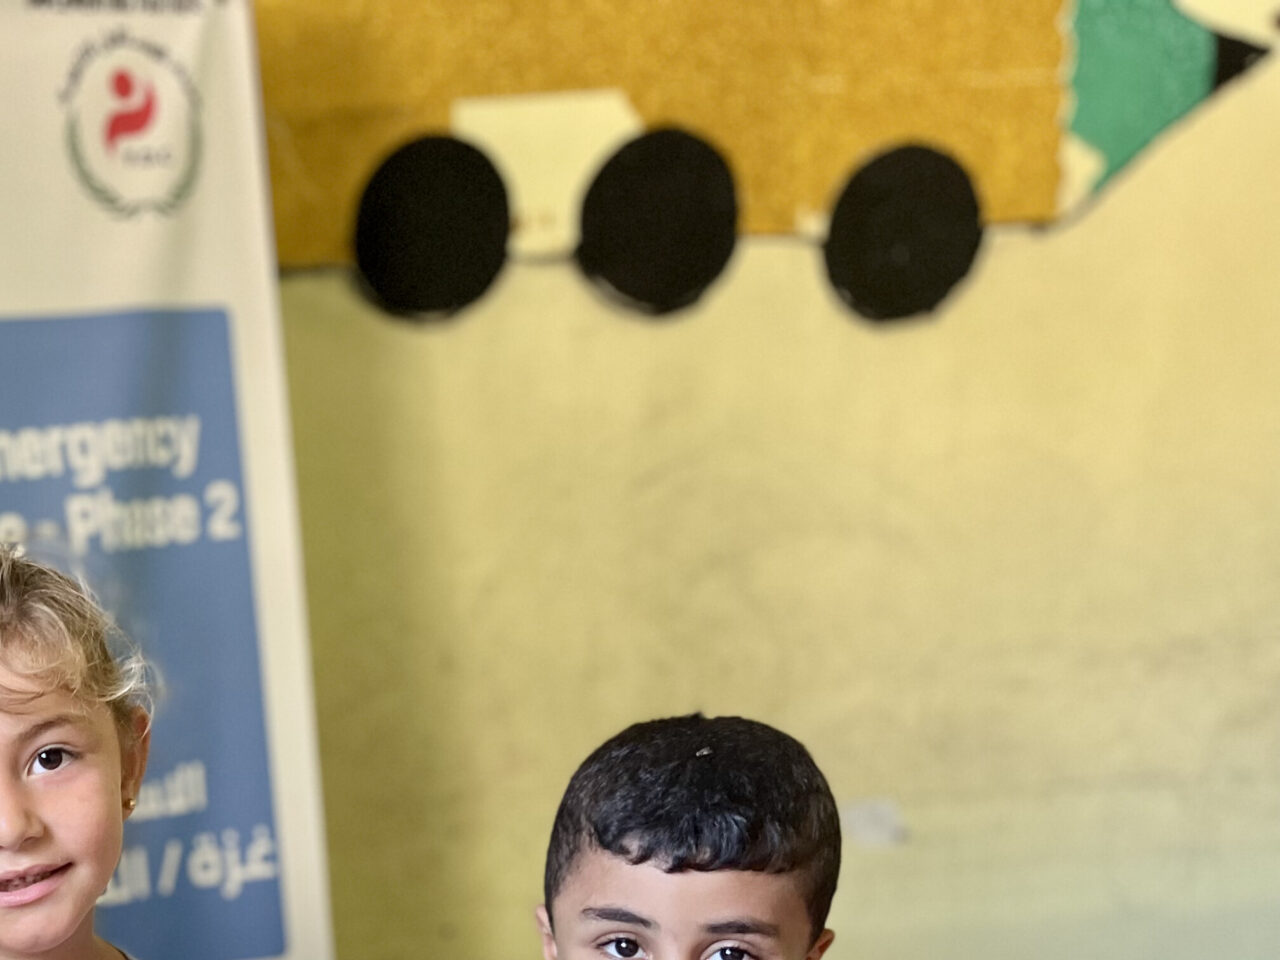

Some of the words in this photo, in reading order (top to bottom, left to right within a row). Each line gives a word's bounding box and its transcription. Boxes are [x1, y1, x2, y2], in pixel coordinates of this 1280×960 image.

[65, 488, 199, 557] Phase
[204, 480, 242, 541] 2
[187, 824, 277, 901] غزة
